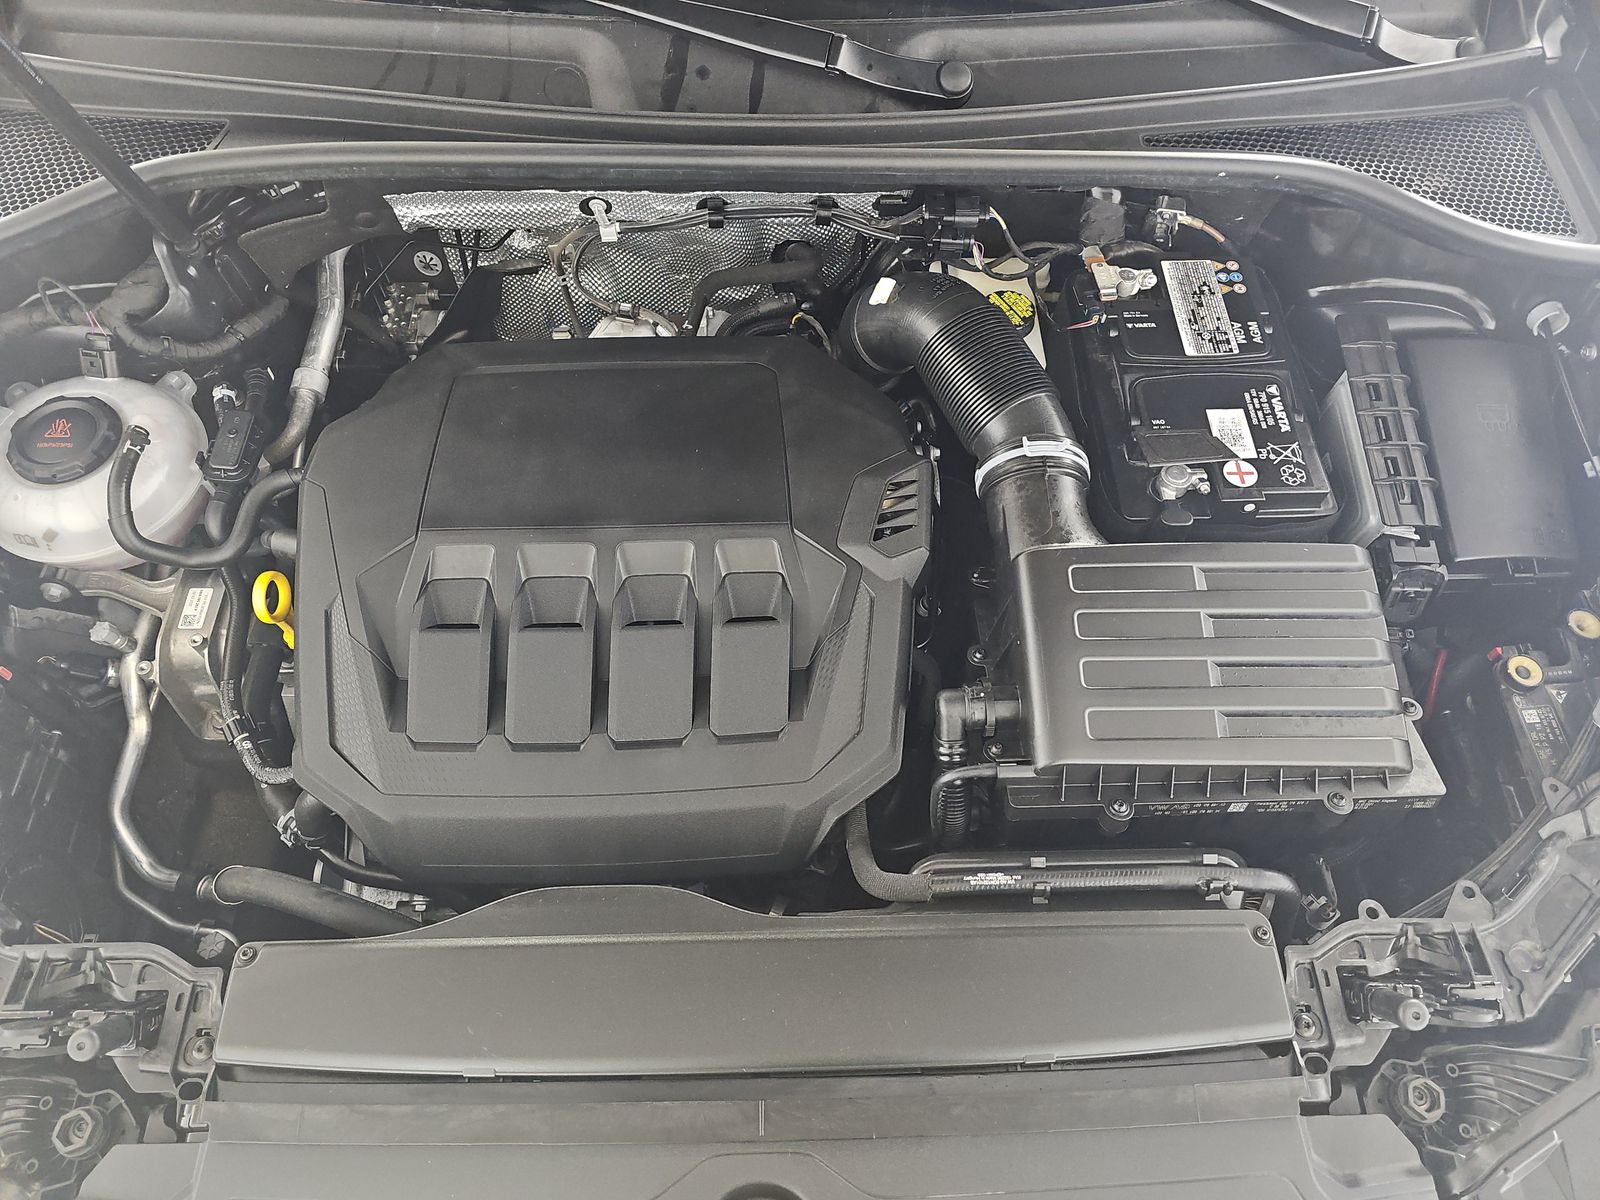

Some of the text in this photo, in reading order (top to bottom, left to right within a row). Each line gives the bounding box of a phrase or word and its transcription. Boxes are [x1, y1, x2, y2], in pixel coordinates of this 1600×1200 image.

[1230, 321, 1248, 344] AGM
[1246, 321, 1264, 344] AGM
[1270, 396, 1291, 432] VARTA
[1256, 448, 1269, 460] Pb
